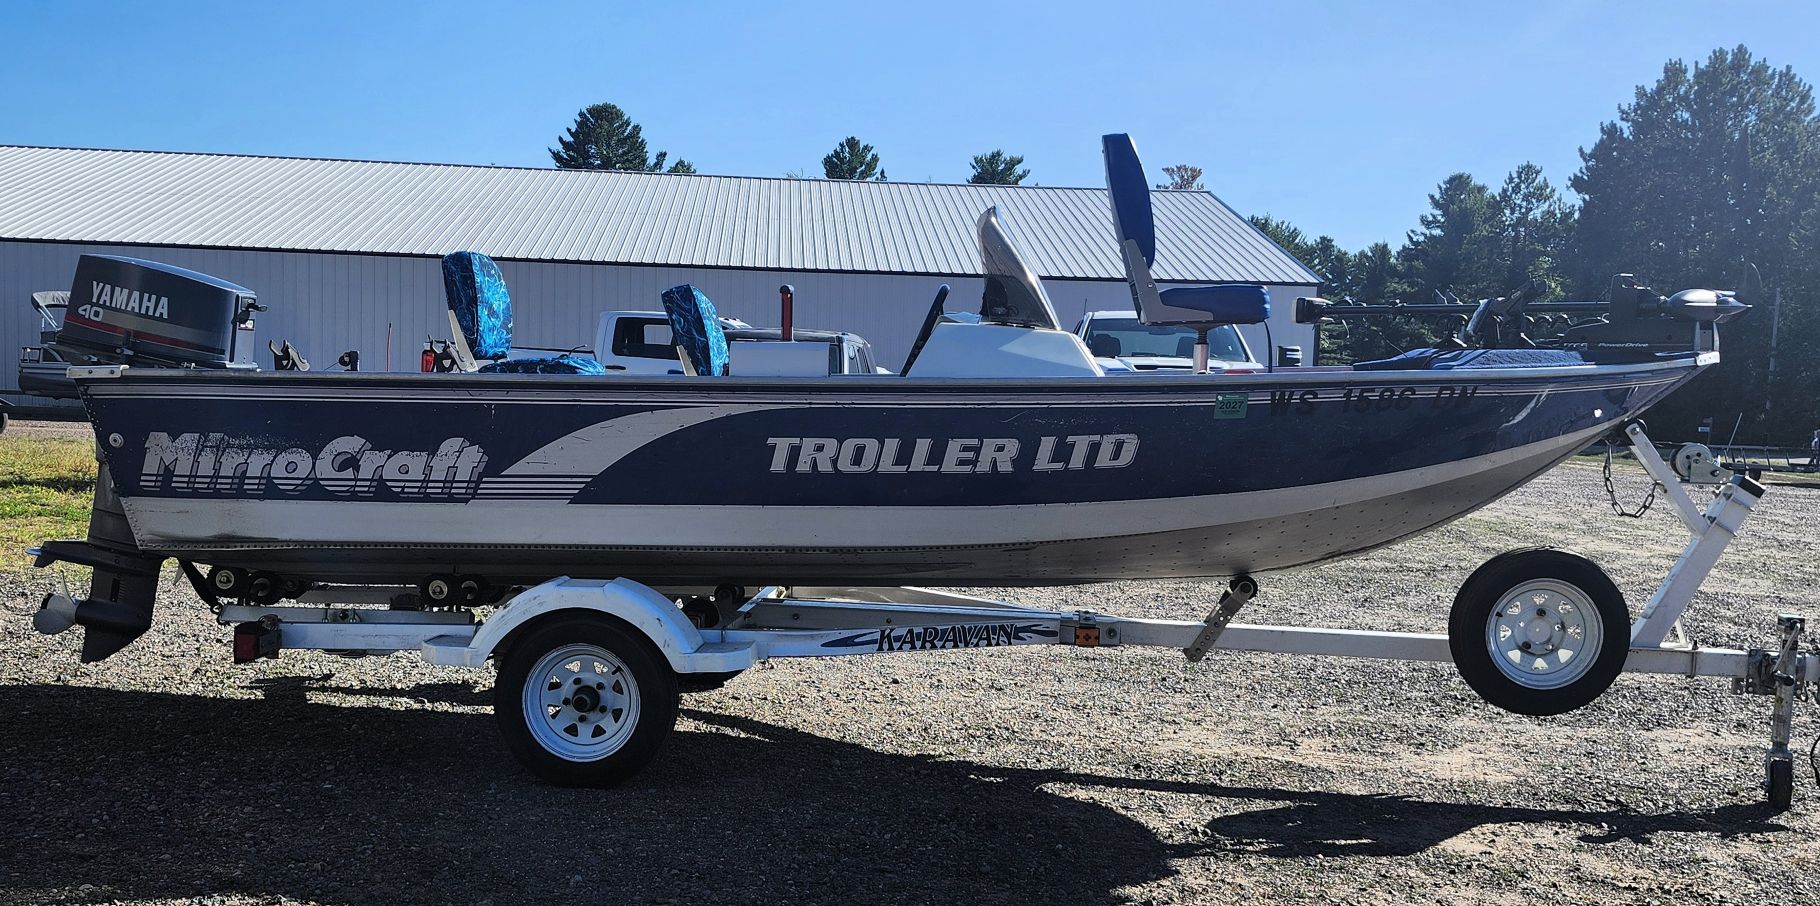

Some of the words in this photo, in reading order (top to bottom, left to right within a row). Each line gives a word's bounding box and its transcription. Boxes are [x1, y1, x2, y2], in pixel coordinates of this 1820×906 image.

[77, 304, 104, 322] 40
[91, 280, 169, 319] YAMAHA
[1219, 400, 1245, 410] 2027
[1270, 390, 1318, 416] WS
[1343, 387, 1417, 414] 1586
[1432, 385, 1479, 409] DN
[139, 431, 489, 498] MirroCraft
[766, 436, 1021, 473] TROLLER
[1031, 433, 1141, 472] LTD
[876, 623, 1017, 651] KARAVAN
